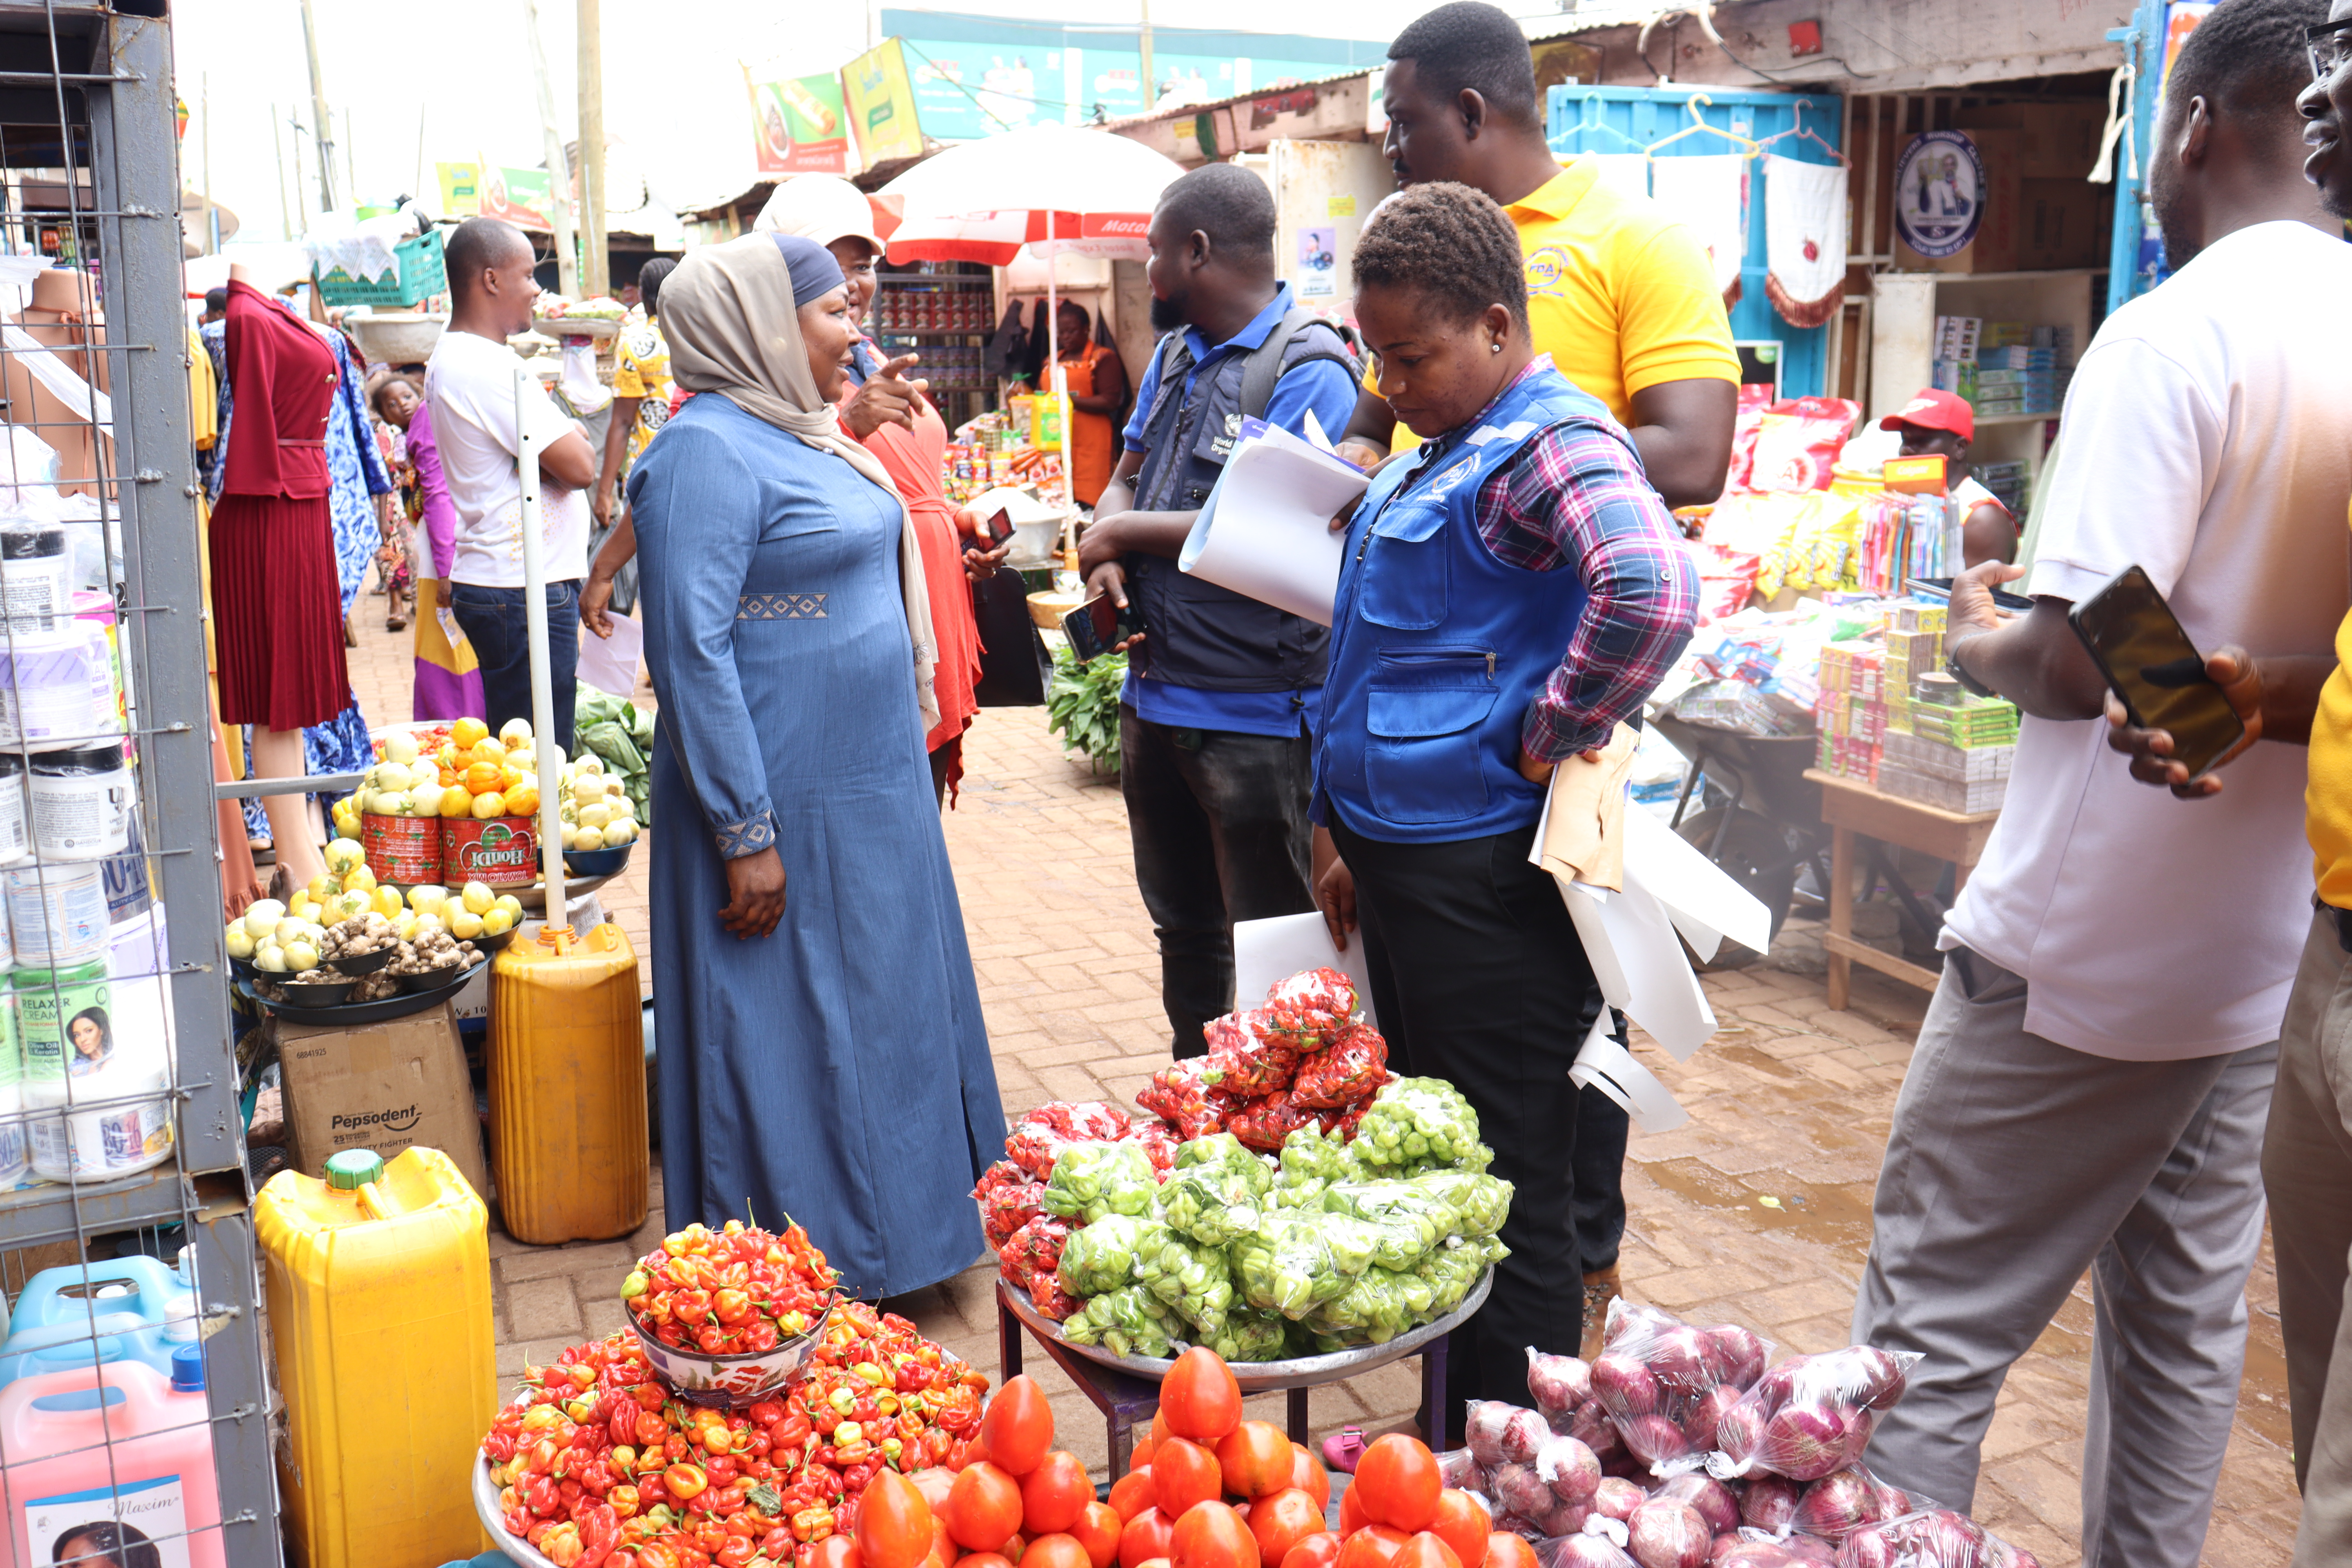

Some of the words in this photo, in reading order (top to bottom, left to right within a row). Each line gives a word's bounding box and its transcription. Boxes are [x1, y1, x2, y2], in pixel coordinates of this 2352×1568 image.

[1528, 263, 1553, 273] FDA
[1214, 436, 1233, 448] World
[1211, 443, 1231, 455] Organ
[1896, 465, 1929, 477] Colgate
[487, 870, 528, 882] TOMATO
[149, 924, 165, 974] PROSSIONAL
[22, 1009, 58, 1020] CREAM
[296, 1048, 327, 1059] 68841925
[332, 1104, 416, 1130] Pepsodent
[379, 1137, 413, 1149] FIGHTER
[108, 1498, 176, 1517] Maxim
